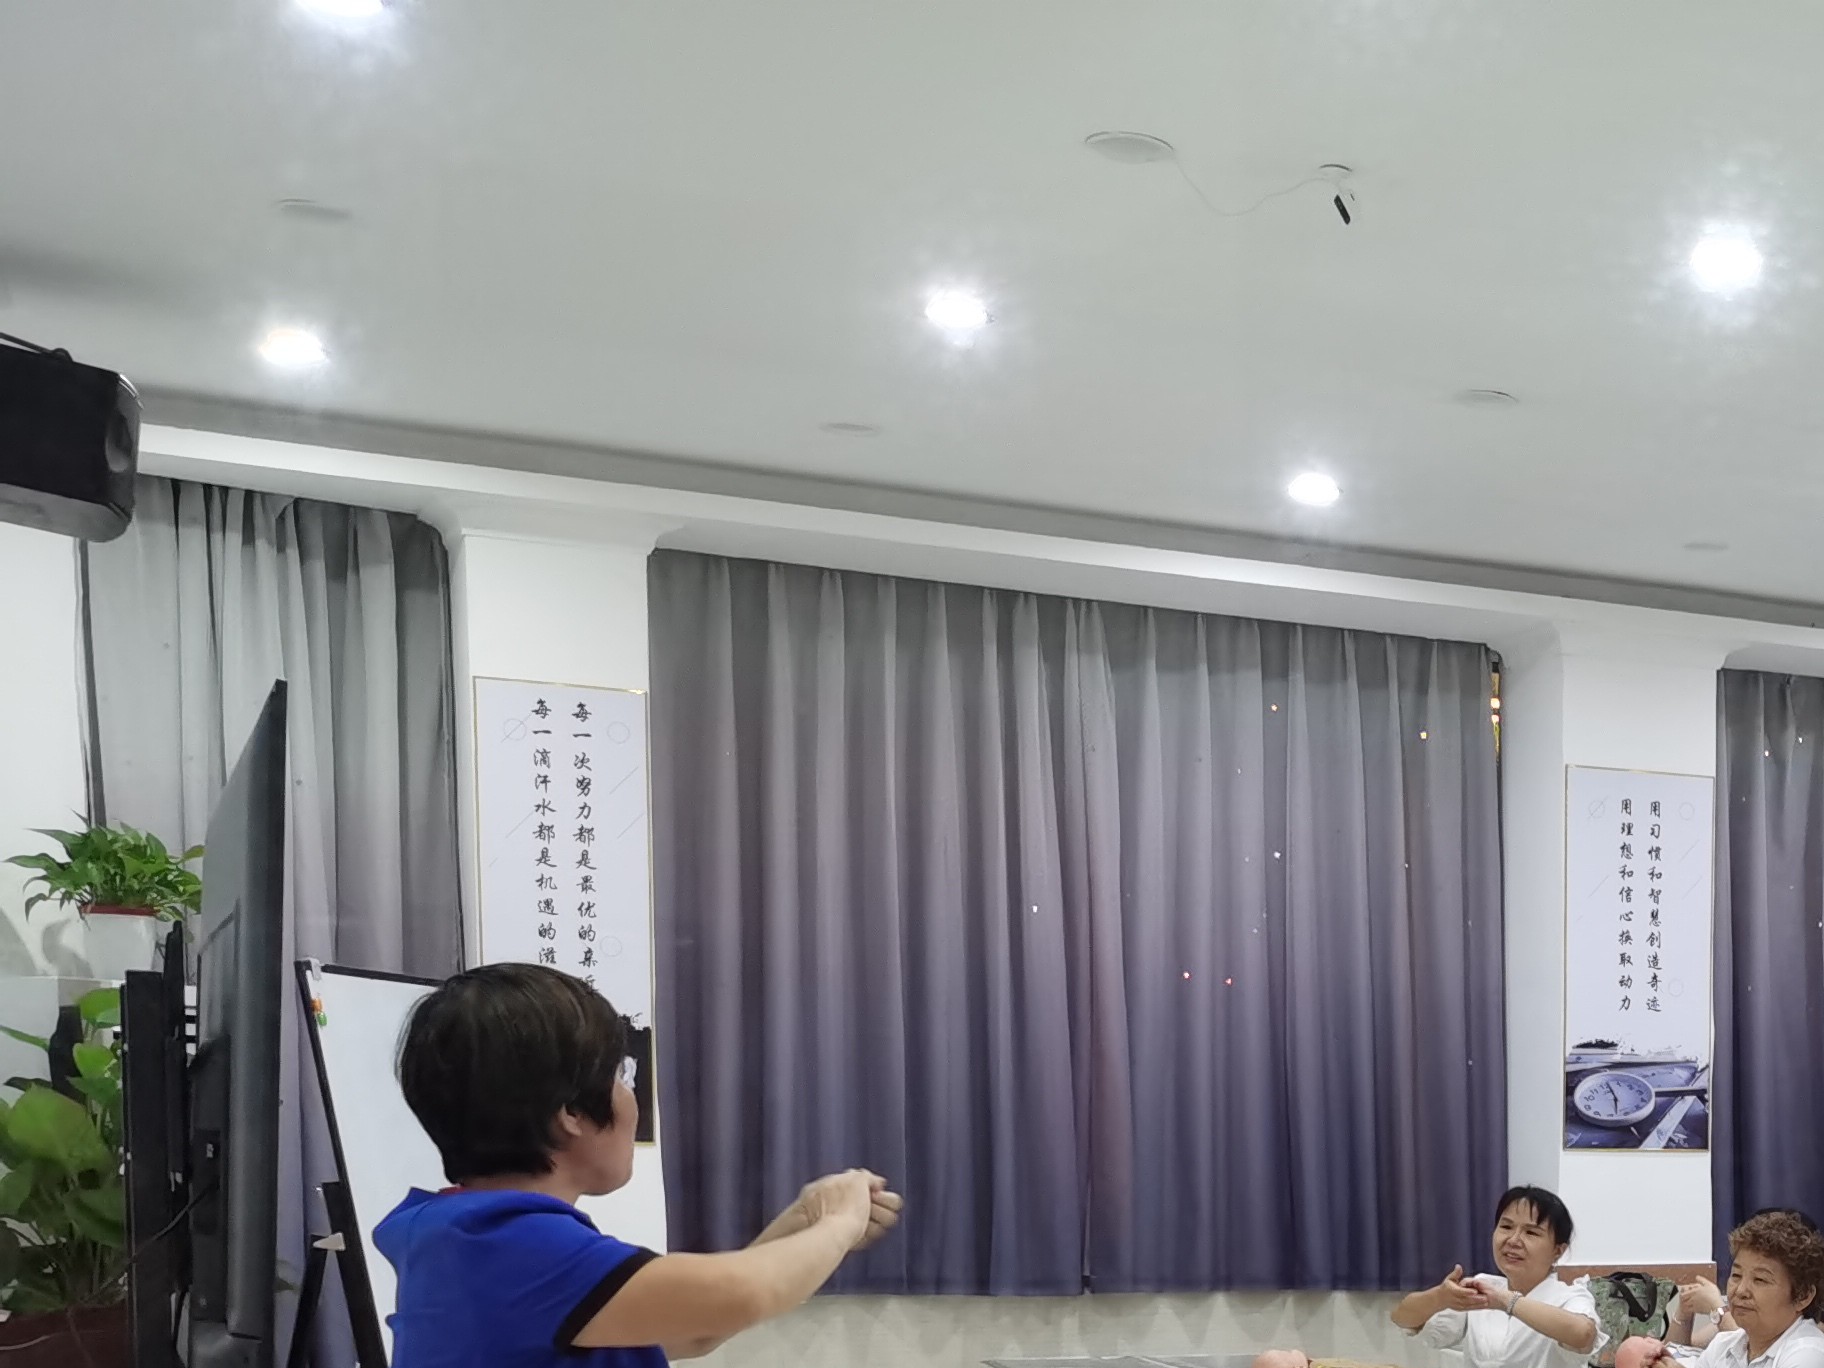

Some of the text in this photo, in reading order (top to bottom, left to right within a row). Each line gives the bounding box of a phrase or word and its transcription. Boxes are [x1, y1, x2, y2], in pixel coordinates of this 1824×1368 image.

[1618, 797, 1636, 1012] 用理想和信心换取动力
[1645, 800, 1664, 1013] 用习惯和智慧创造奇迹
